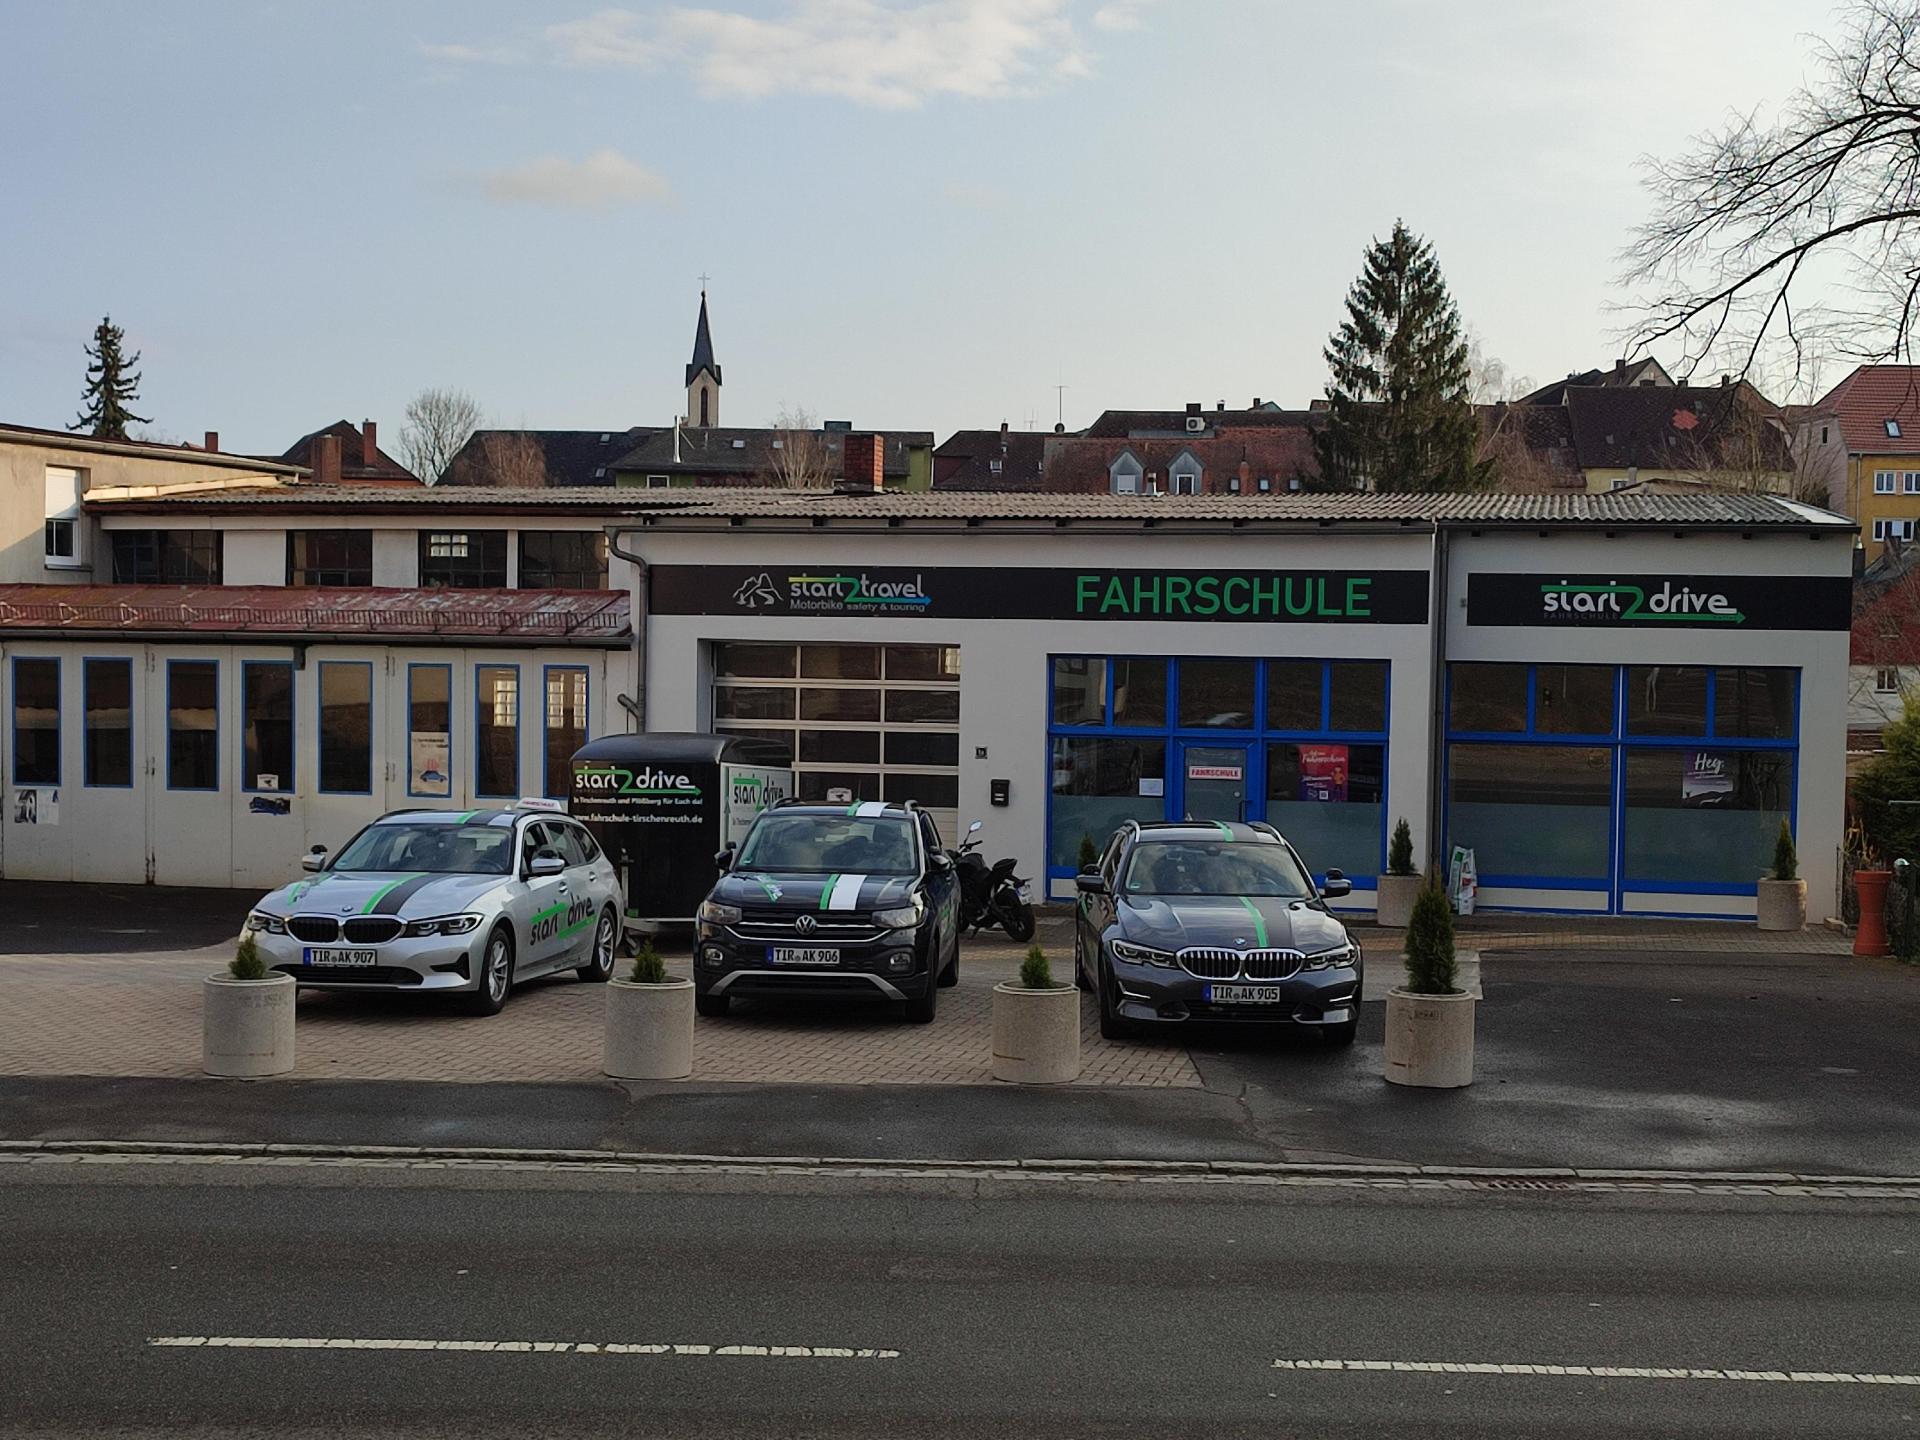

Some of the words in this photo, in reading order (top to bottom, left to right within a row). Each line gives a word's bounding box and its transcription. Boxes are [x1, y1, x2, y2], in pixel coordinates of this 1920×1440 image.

[1076, 575, 1371, 616] FAHRSCHULE
[790, 598, 844, 610] Motorbike
[846, 603, 877, 613] safety
[880, 603, 888, 611] &
[890, 604, 925, 613] touring
[1543, 612, 1618, 620] FAHRSCHULE
[1191, 768, 1239, 777] FAHRSCHULE
[312, 950, 330, 962] TIR
[338, 951, 352, 963] AK
[353, 951, 374, 964] 907
[775, 949, 794, 961] TIR
[802, 950, 816, 962] AK
[818, 950, 838, 962] 906
[1212, 986, 1233, 999] TIR
[1241, 987, 1256, 1000] AK
[1257, 988, 1278, 1000] 905
